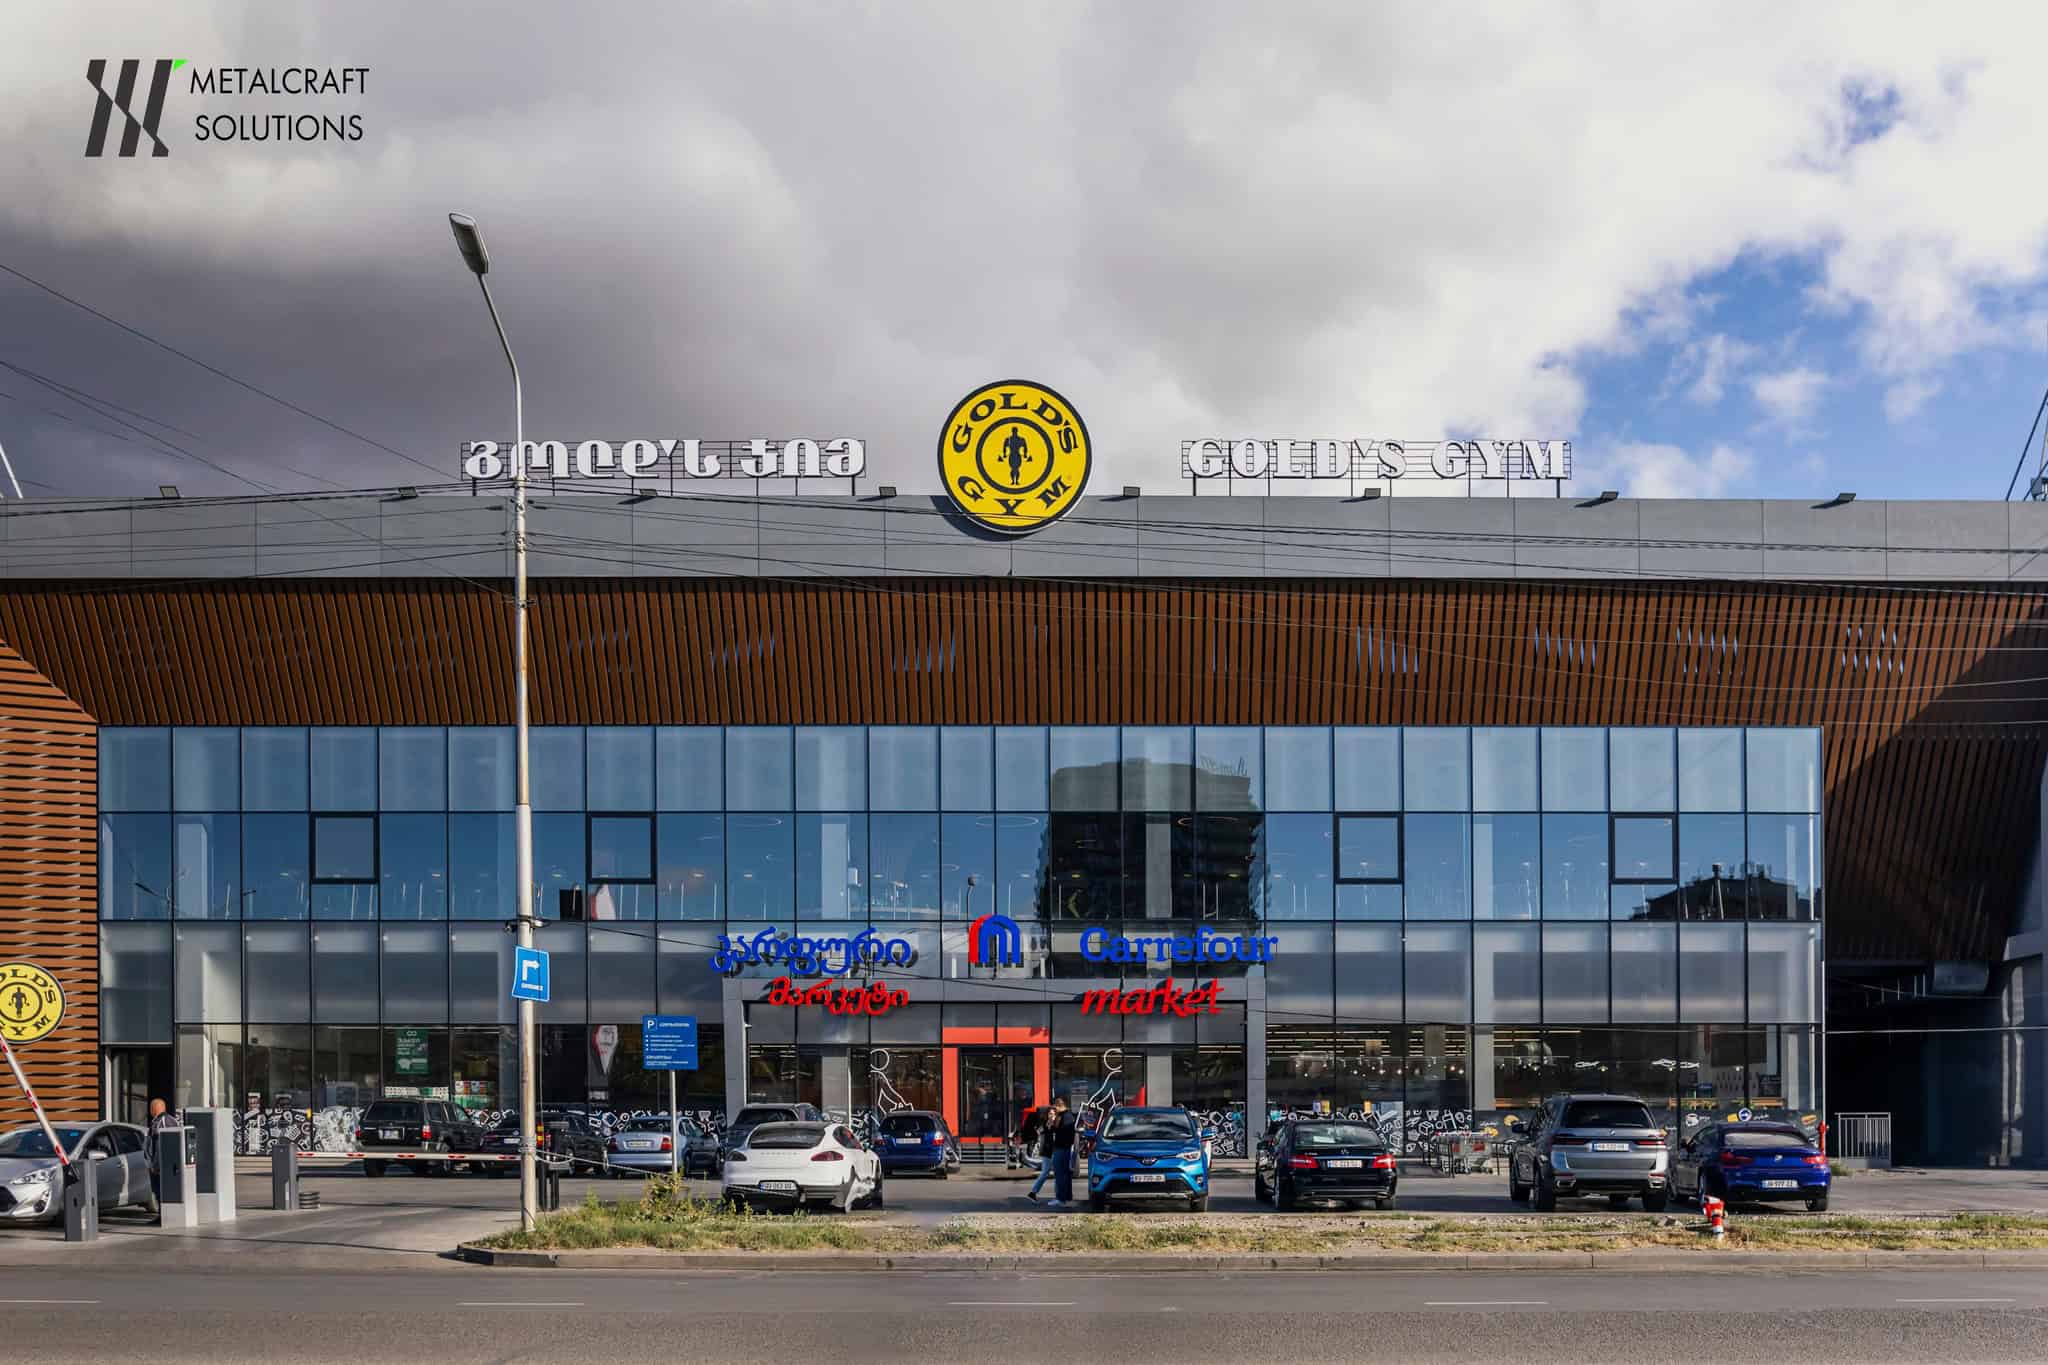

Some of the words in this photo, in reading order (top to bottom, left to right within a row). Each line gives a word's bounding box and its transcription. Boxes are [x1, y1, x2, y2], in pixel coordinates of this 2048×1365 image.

[952, 392, 1079, 454] GOLD'S
[1187, 438, 1408, 479] GOLD'S
[1431, 439, 1569, 479] GYM
[957, 475, 1073, 516] GYM
[1079, 925, 1279, 963] Carrefour
[768, 976, 910, 1016] მარკეტი
[1080, 976, 1225, 1018] market
[0, 1015, 51, 1036] YM
